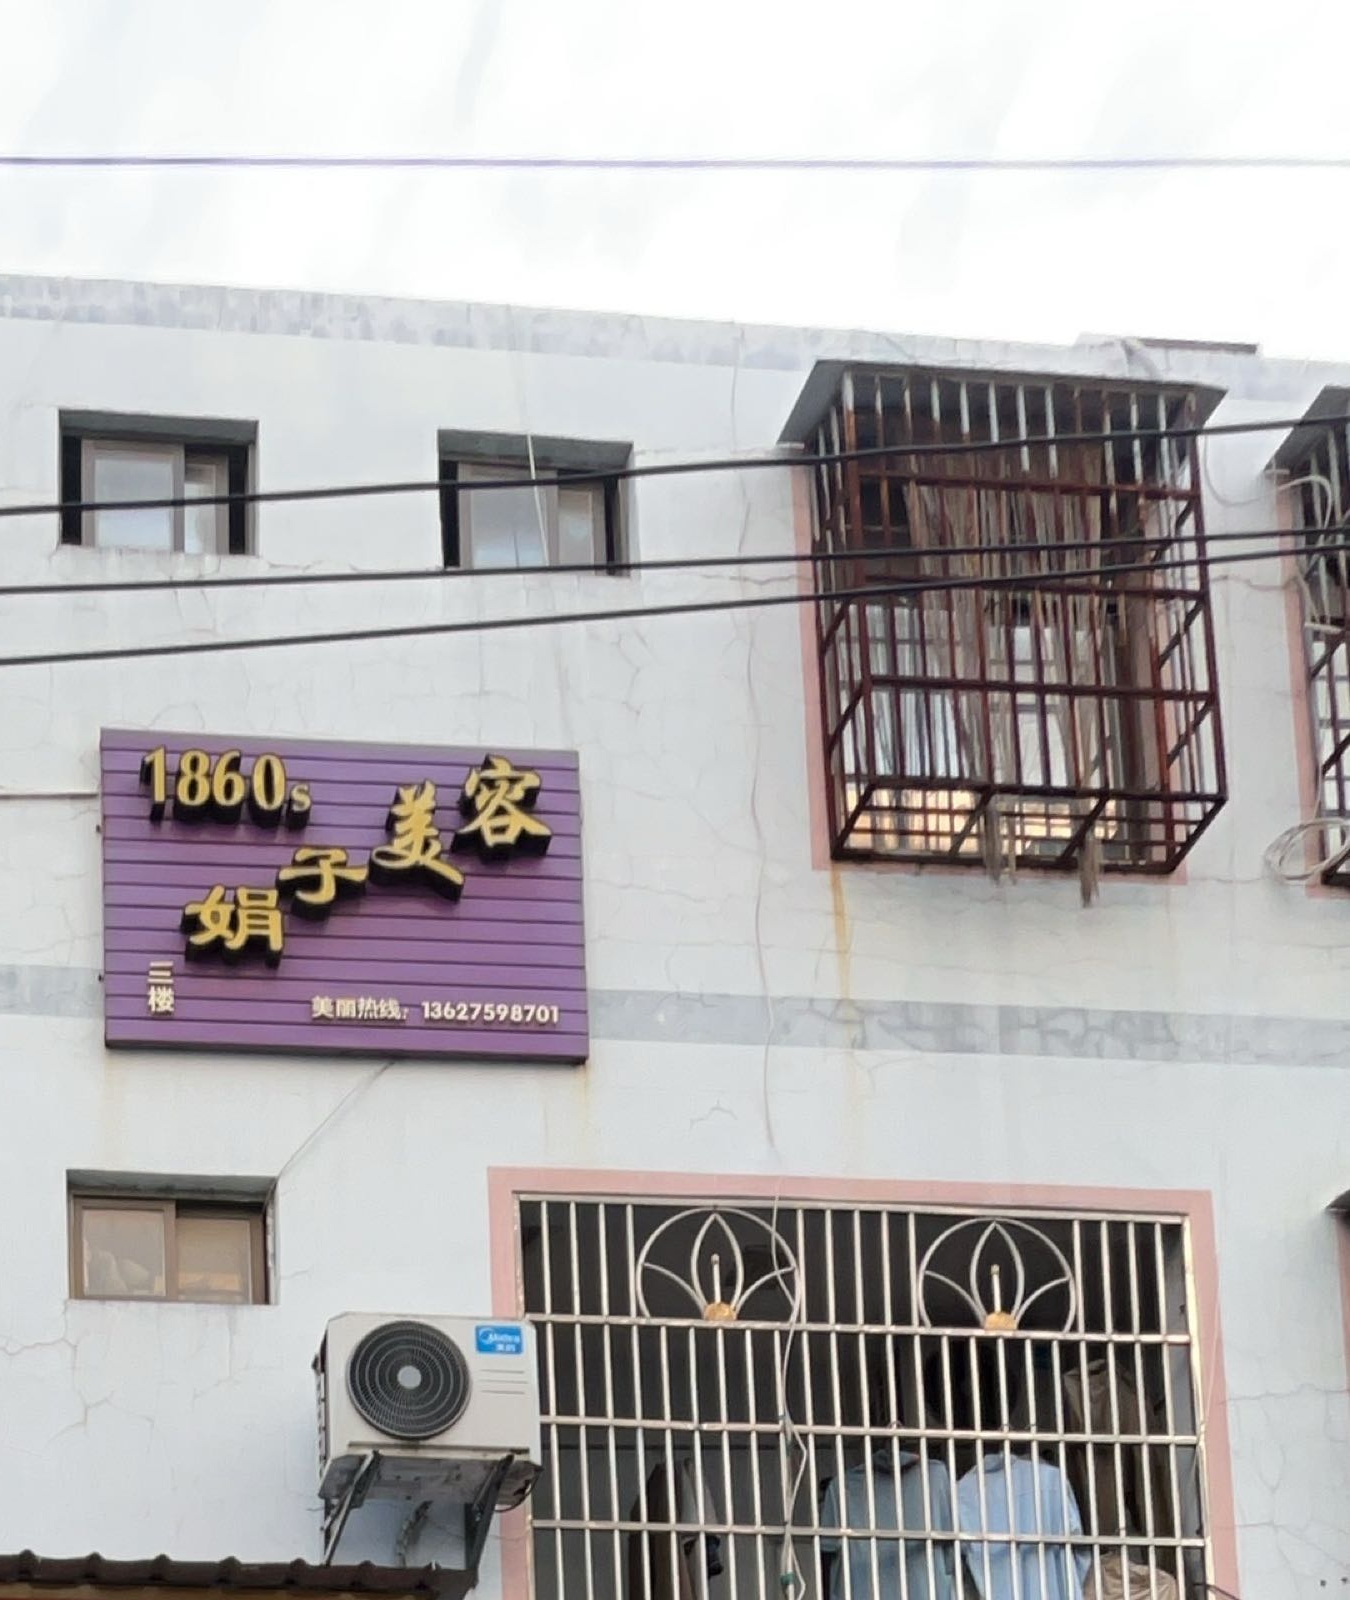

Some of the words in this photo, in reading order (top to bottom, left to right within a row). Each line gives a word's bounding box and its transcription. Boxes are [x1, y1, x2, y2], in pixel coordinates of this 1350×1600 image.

[140, 746, 311, 827] 1860s
[181, 753, 553, 968] 娟子美容
[147, 960, 175, 1014] 三楼
[420, 1001, 560, 1025] 13627598701
